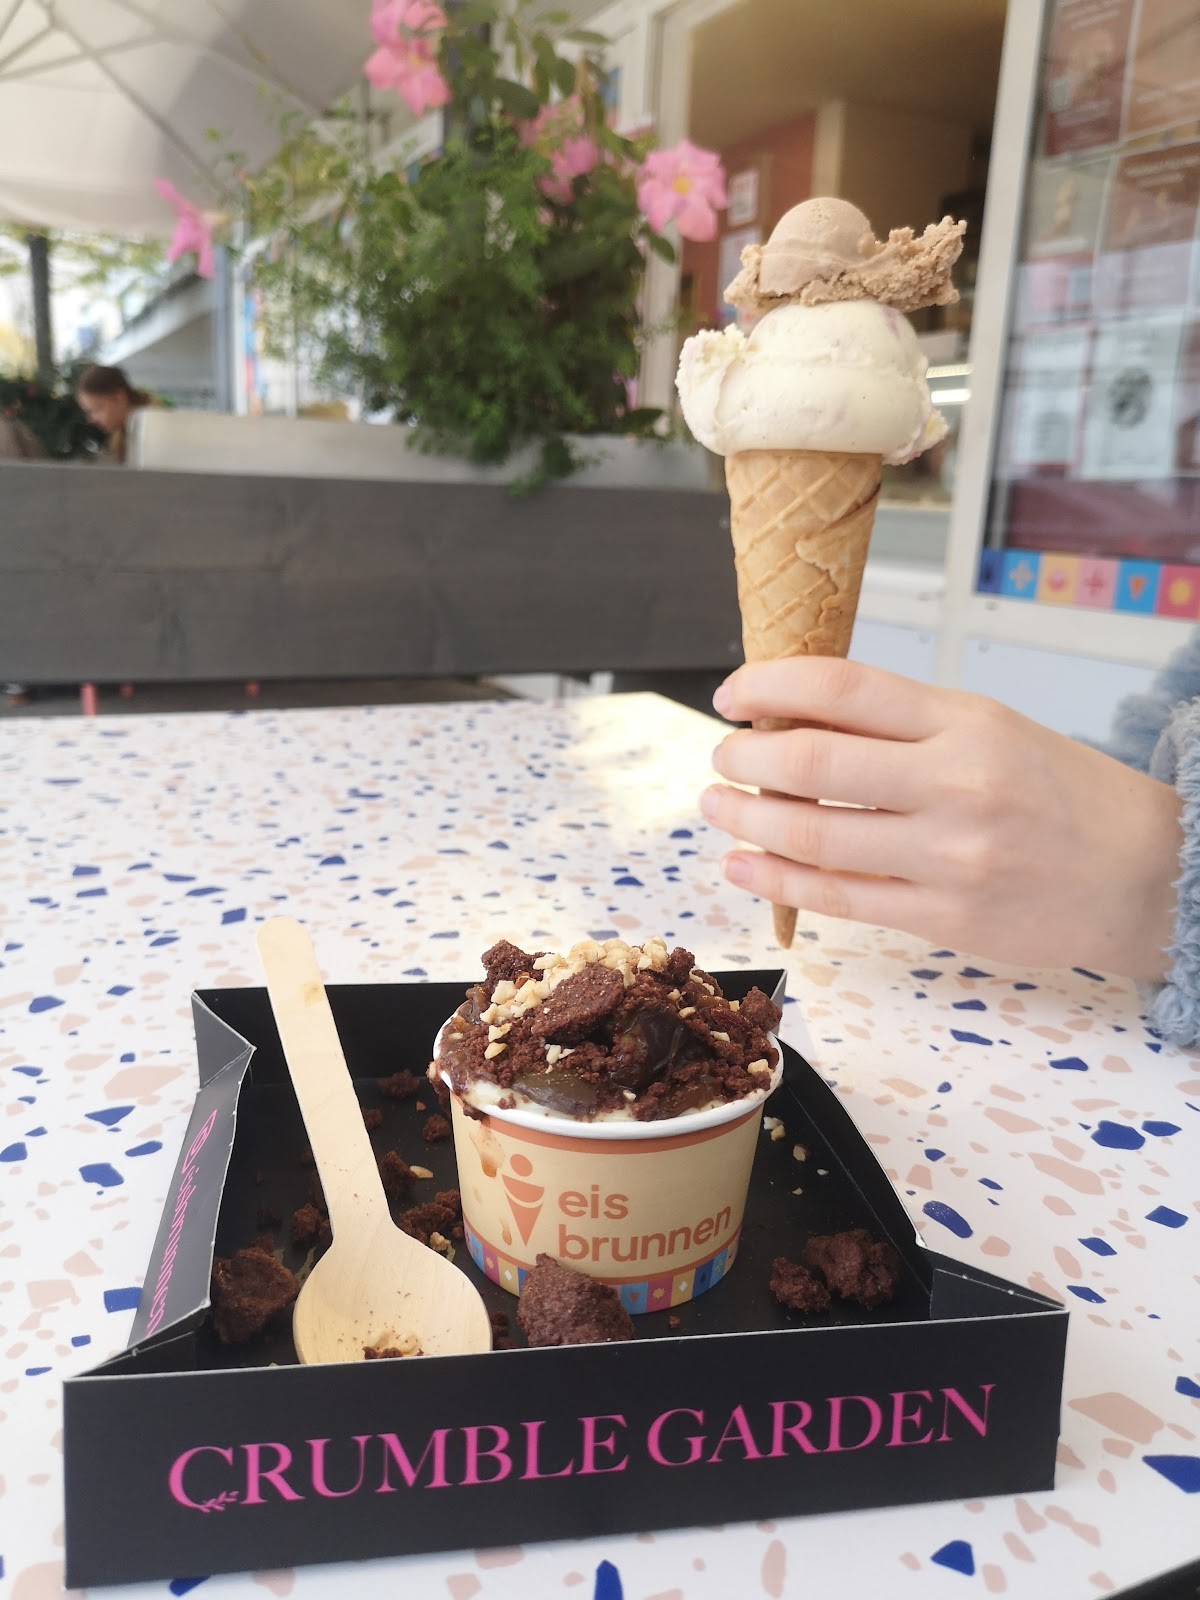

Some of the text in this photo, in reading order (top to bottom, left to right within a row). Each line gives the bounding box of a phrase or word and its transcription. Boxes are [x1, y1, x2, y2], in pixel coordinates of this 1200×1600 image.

[557, 1184, 629, 1220] eis
[558, 1205, 732, 1263] brunnen
[167, 1383, 997, 1513] CRUMBLE GARDEN
